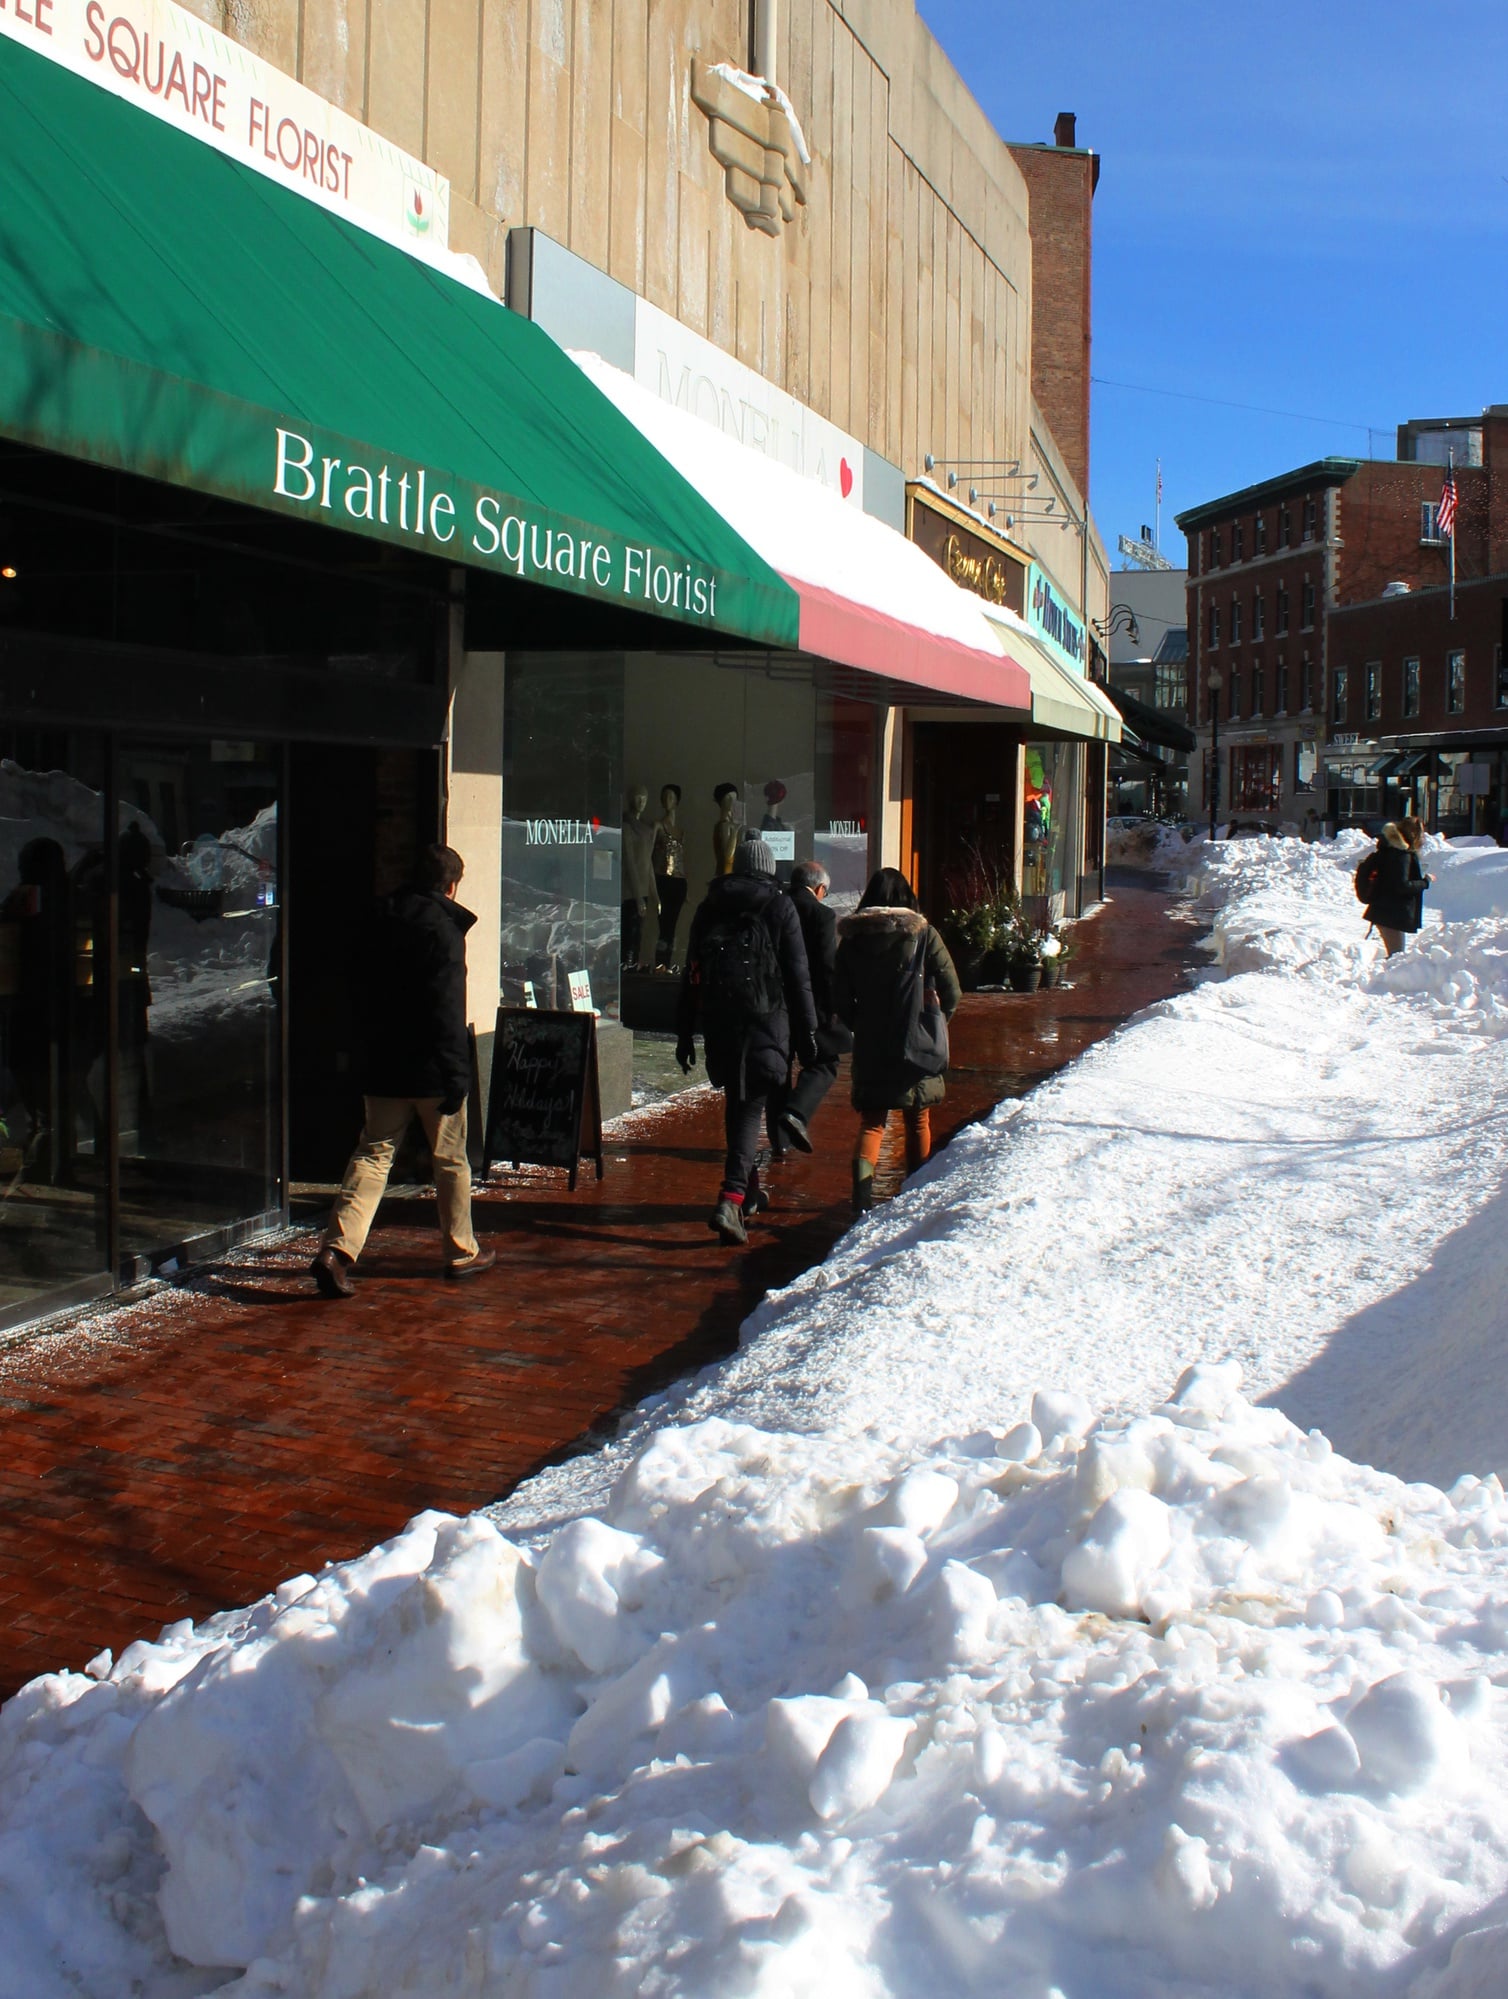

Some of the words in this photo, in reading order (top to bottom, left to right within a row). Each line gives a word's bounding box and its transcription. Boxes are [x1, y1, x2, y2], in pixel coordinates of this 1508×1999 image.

[84, 0, 227, 132] SQUARE
[249, 96, 354, 201] FLORIST
[272, 427, 456, 543] Brattle
[472, 496, 612, 588] Square
[623, 545, 717, 618] Florist
[525, 818, 594, 846] MONELLA
[829, 820, 860, 838] MONELLA
[572, 984, 590, 1000] SALE
[507, 1040, 560, 1084] Happy
